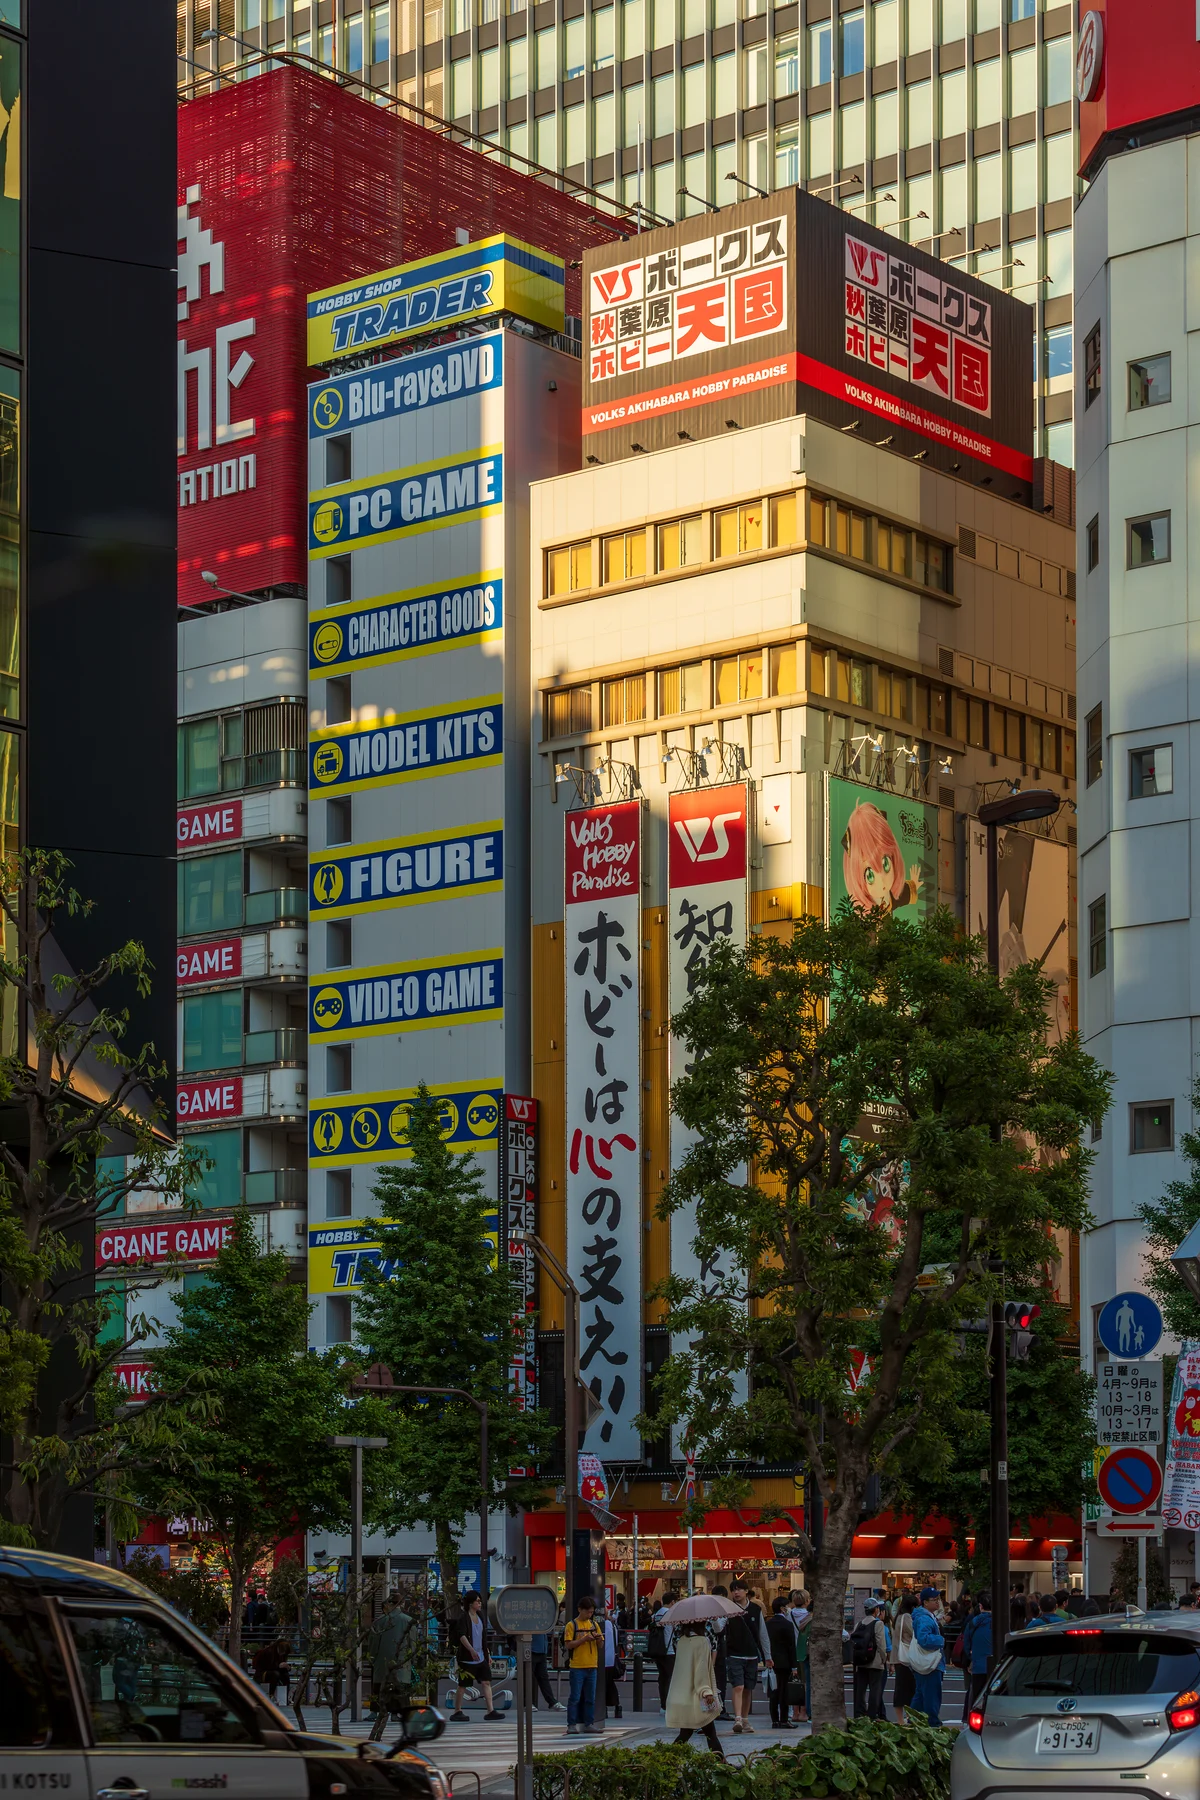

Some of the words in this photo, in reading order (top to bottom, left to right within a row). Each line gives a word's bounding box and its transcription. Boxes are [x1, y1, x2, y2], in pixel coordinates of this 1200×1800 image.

[647, 219, 785, 294] ボークス
[316, 288, 361, 313] HOBBY
[364, 278, 402, 299] SHOP
[331, 270, 494, 352] TRADER
[846, 283, 908, 340] 秋葉原
[890, 262, 989, 343] ボークス
[592, 297, 670, 344] 秋葉原
[348, 344, 494, 422] Blu-ray&DVD
[591, 407, 626, 424] VOLKS
[627, 390, 690, 416] AKIHABARA
[692, 379, 730, 397] HOBBY
[732, 363, 788, 387] PARADISE
[845, 383, 873, 405] VOLKS
[874, 396, 922, 427] AKIHABARA
[923, 419, 952, 439] HOBBY
[953, 431, 992, 457] PARADISE
[350, 488, 392, 535] PC
[401, 461, 495, 522] GAME
[348, 599, 437, 656] CHARACTER
[440, 585, 495, 636] GOODS
[349, 724, 431, 777] MODEL
[436, 710, 495, 760] KITS
[177, 808, 234, 841] GAME
[350, 836, 495, 900] FIGURE
[572, 864, 634, 898] Paradise
[177, 946, 233, 978] GAME
[348, 975, 420, 1023] VIDEO
[425, 964, 495, 1013] GAME
[177, 1085, 235, 1115] GAME
[525, 1122, 535, 1185] VOLKS
[100, 1231, 168, 1260] CRANE
[1104, 1365, 1139, 1376] 日曜の
[1100, 1430, 1160, 1442] (特定禁止区間)
[609, 1560, 620, 1570] 1F
[723, 1560, 734, 1570] 2F
[1052, 1732, 1093, 1748] 91-34
[12, 1773, 71, 1789] KOTSU
[171, 1774, 228, 1789] musashi
